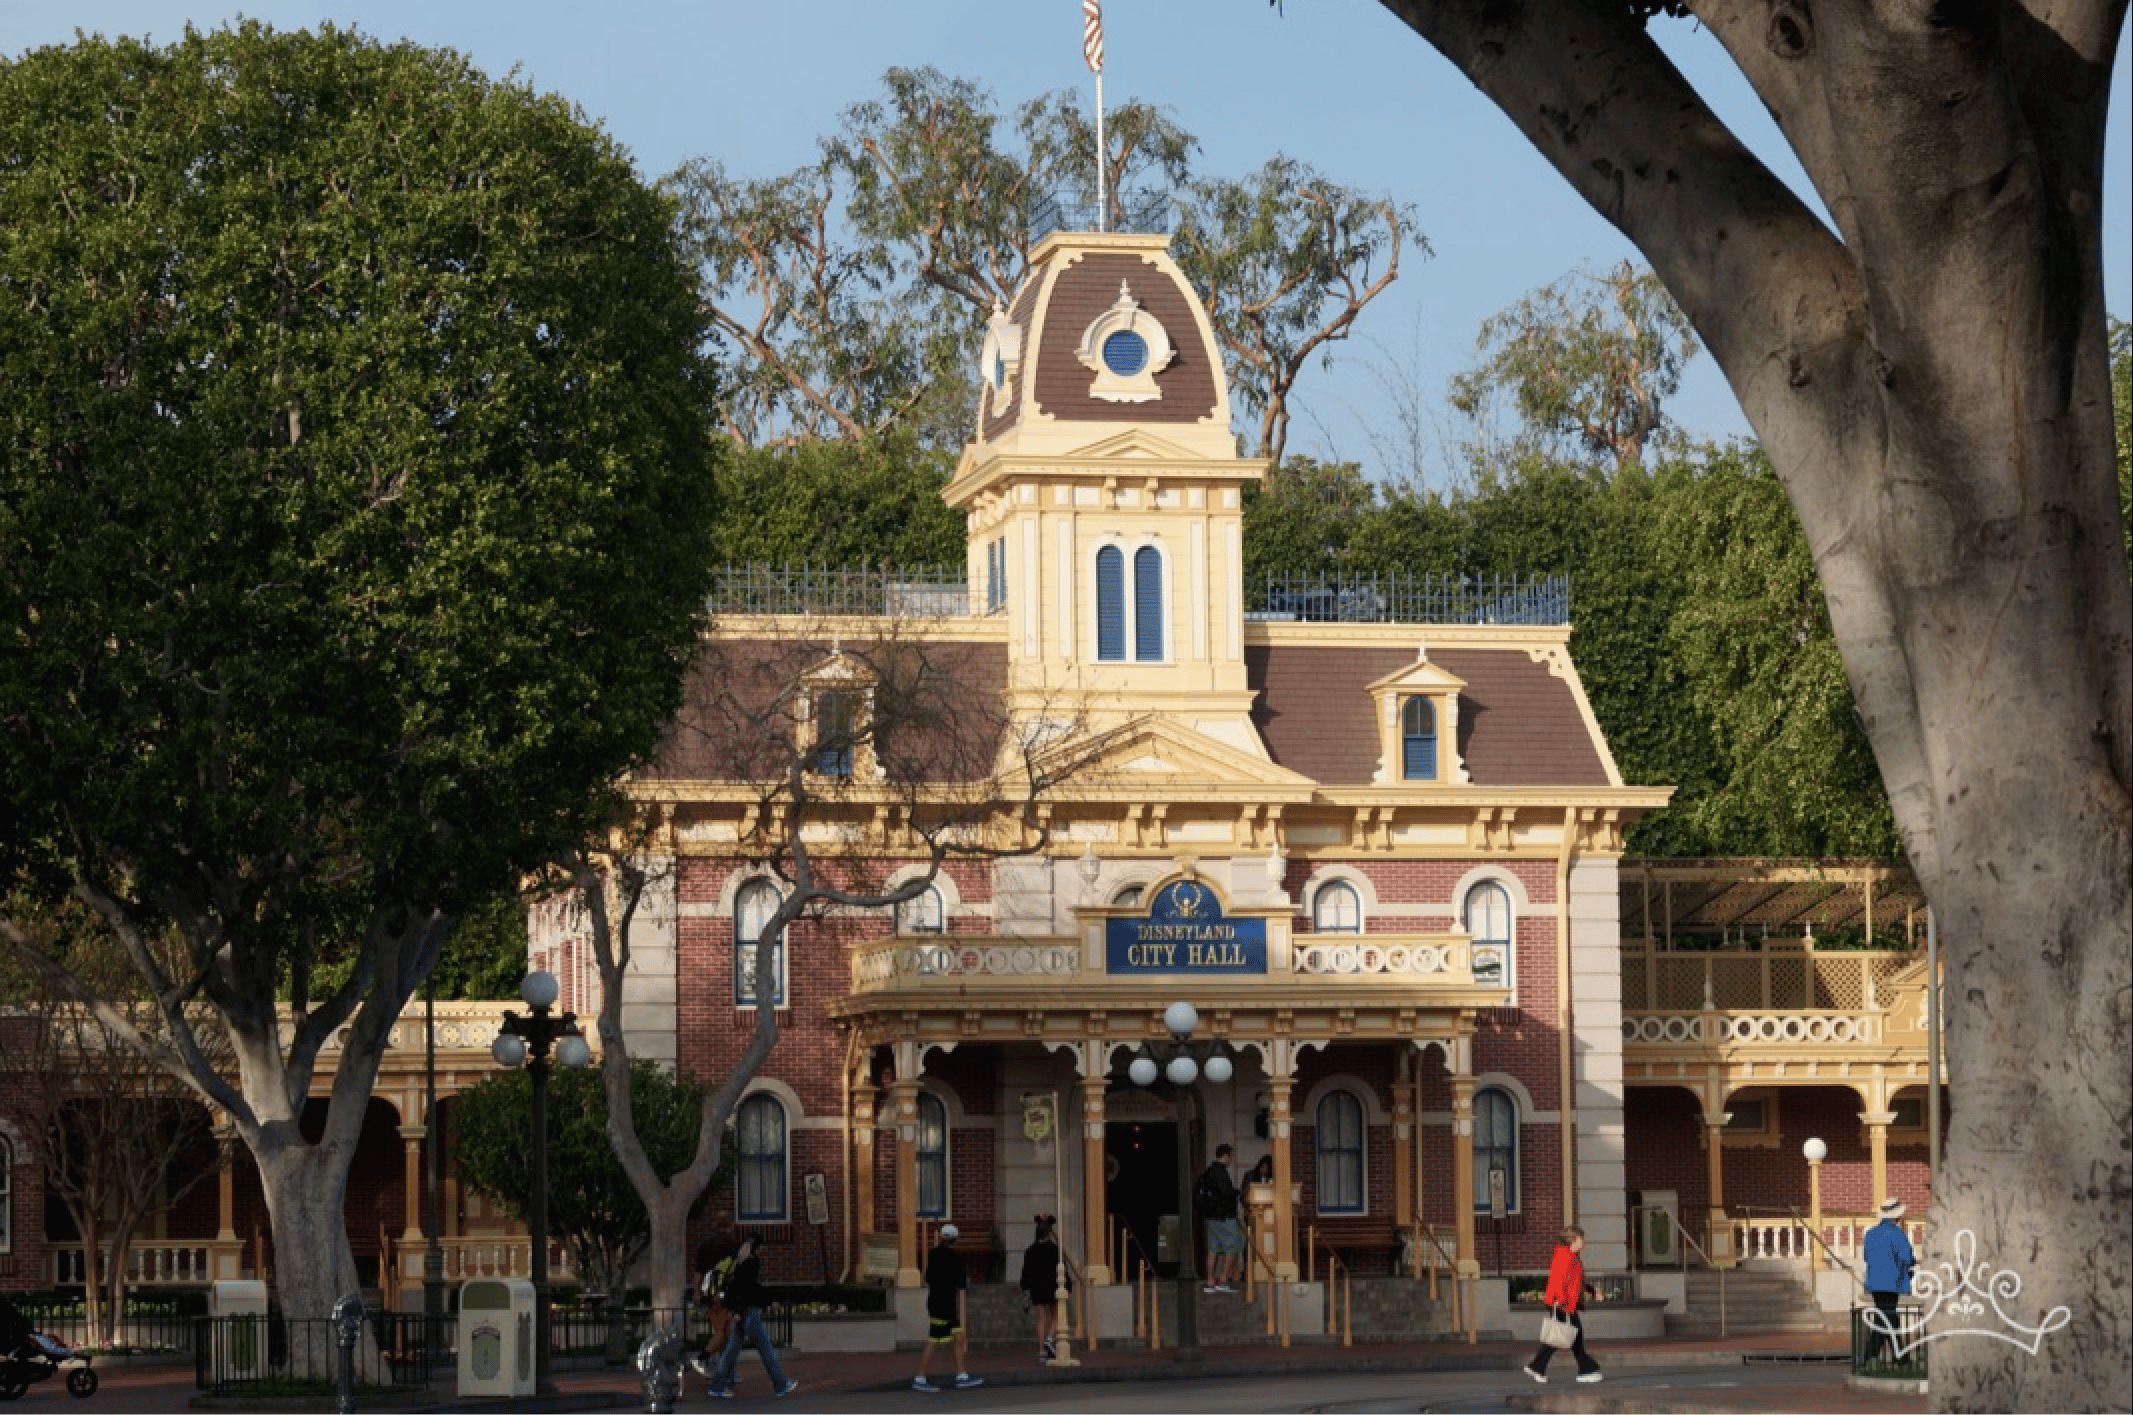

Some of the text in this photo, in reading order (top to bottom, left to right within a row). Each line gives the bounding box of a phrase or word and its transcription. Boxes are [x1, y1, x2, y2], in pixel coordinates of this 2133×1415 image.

[1137, 924, 1235, 940] DISNEYLAND
[1127, 943, 1247, 966] CITY HALL
